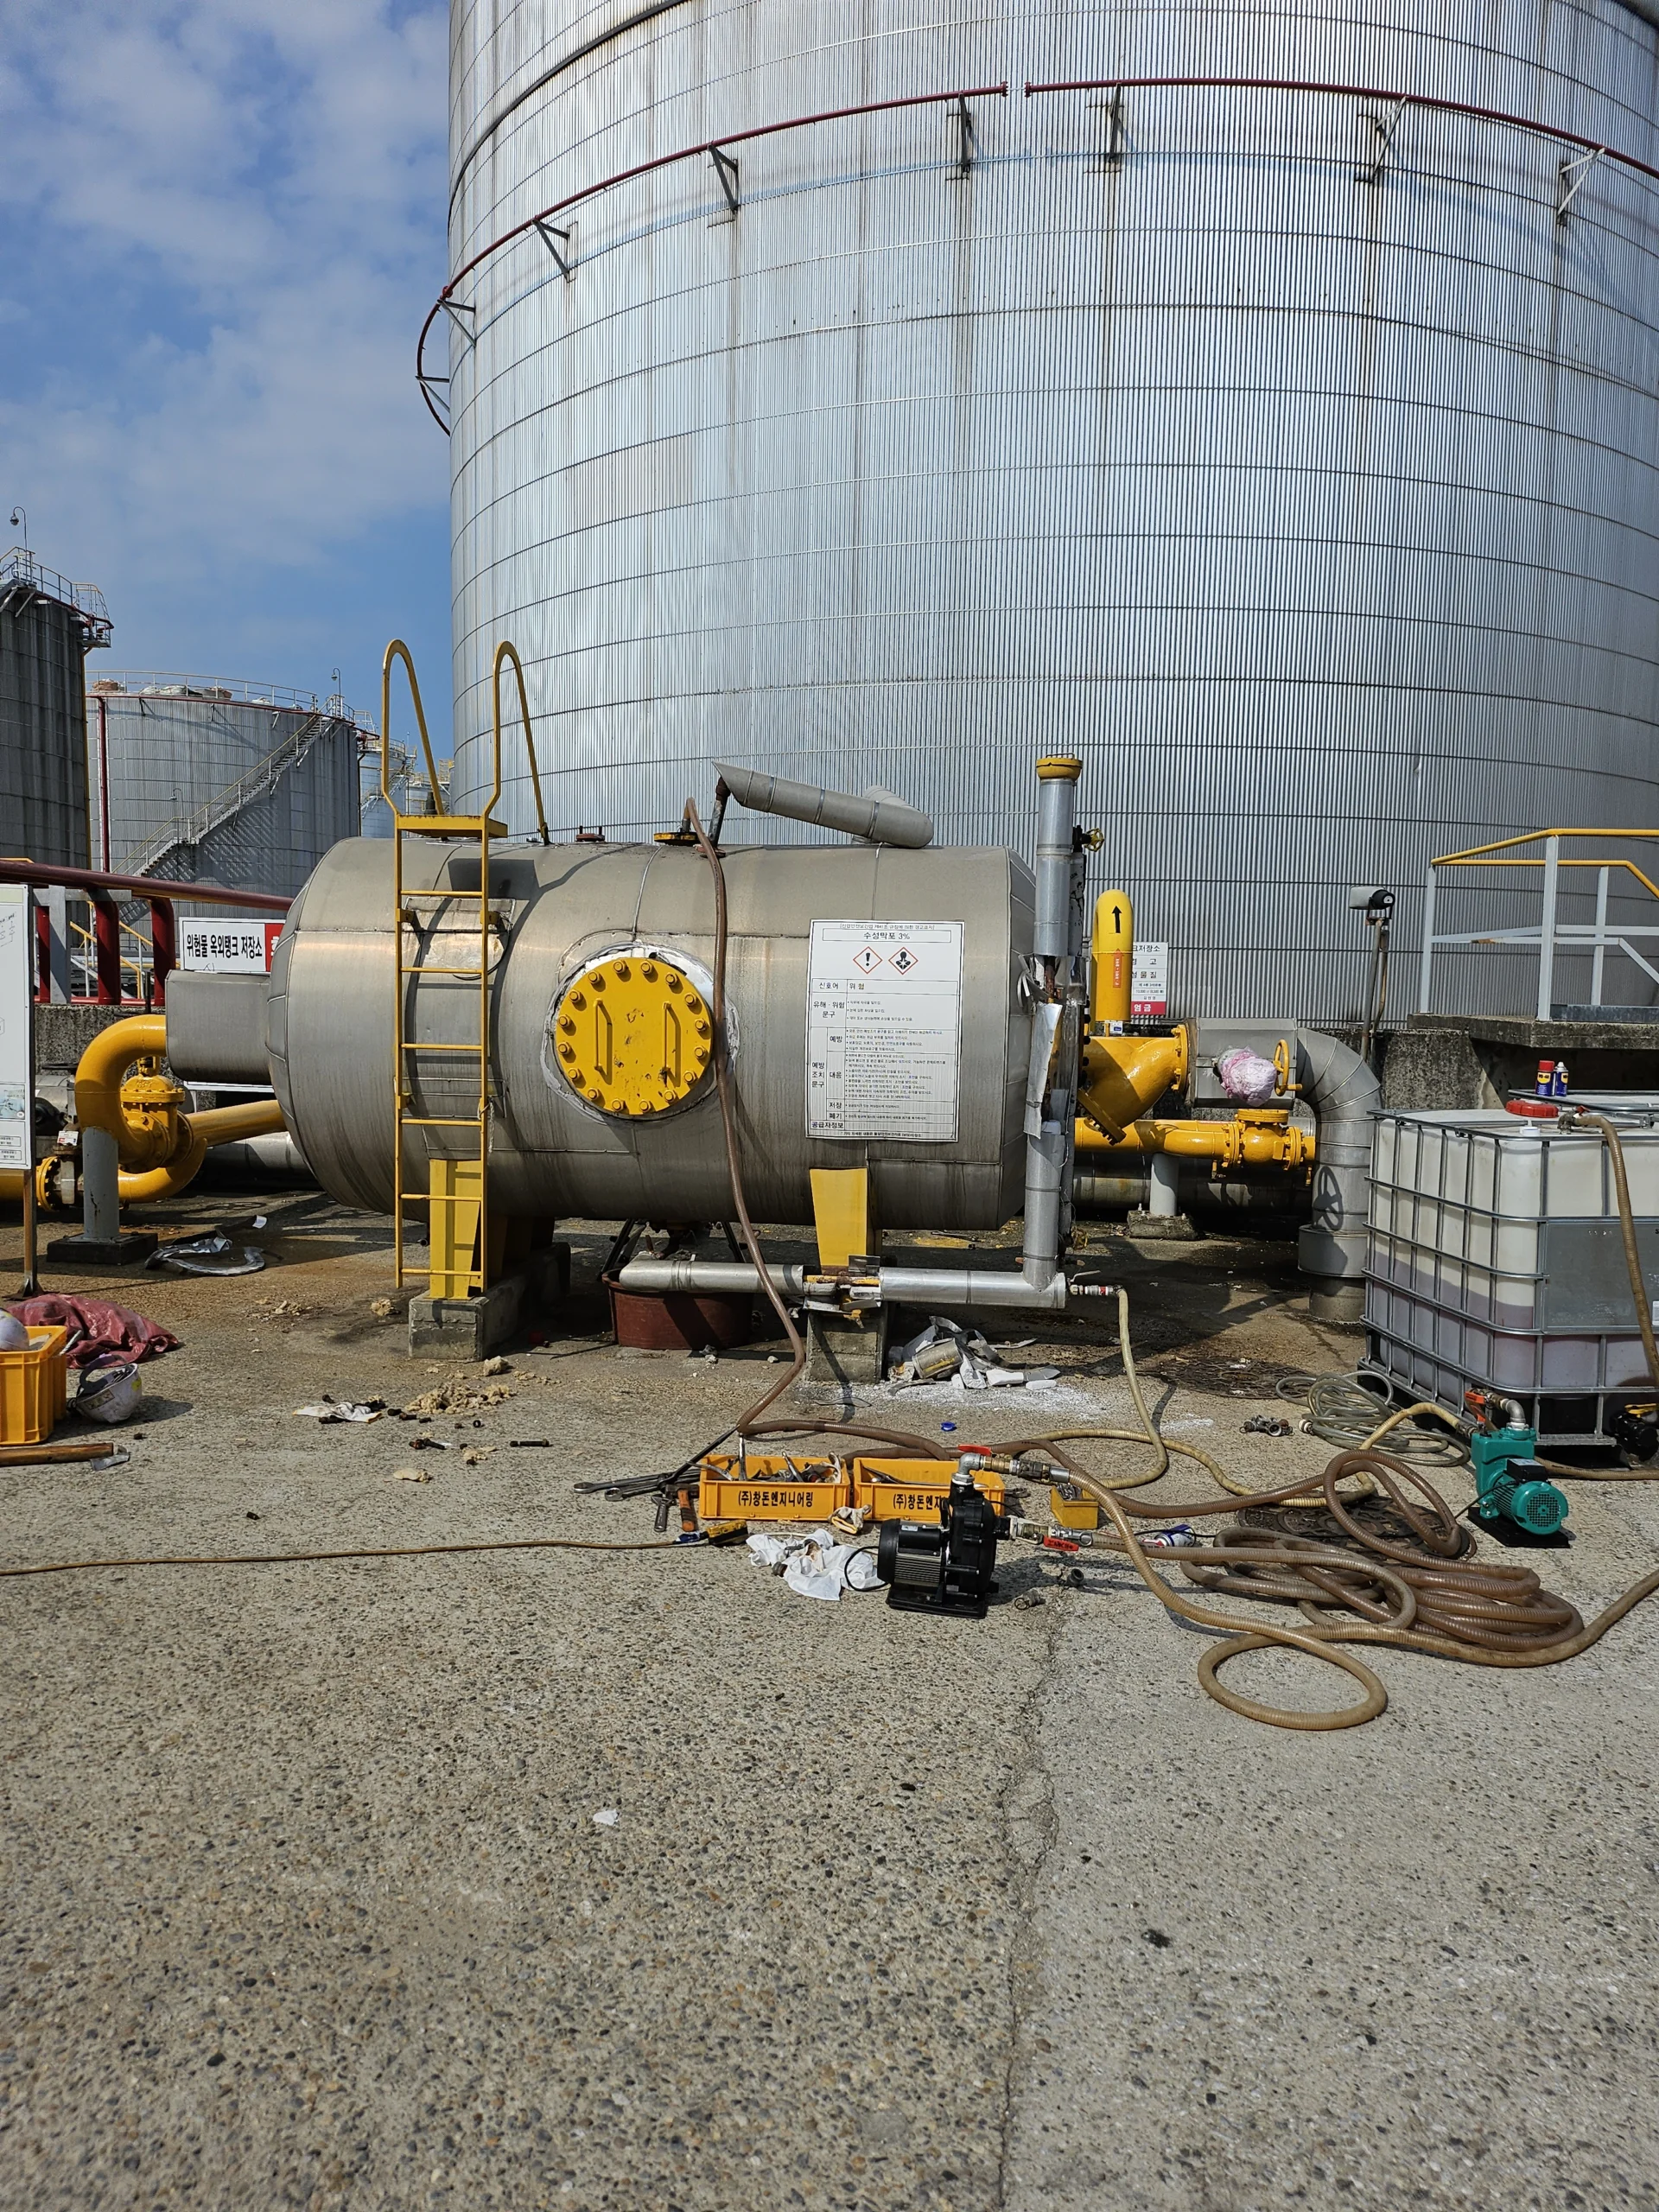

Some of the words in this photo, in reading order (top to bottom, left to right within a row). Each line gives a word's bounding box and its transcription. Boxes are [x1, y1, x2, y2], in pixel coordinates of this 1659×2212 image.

[187, 933, 207, 957] 위험물
[210, 934, 239, 958] 옥외탱크
[241, 935, 262, 959] 저장소
[819, 982, 839, 990] 신호어
[823, 1010, 836, 1019] 문구
[812, 1061, 825, 1070] 예방
[811, 1071, 825, 1079] 조치
[830, 1071, 842, 1079] 대응
[811, 1080, 825, 1089] 문구
[811, 1121, 844, 1129] 공급자정보
[738, 1490, 814, 1508] (주)창돈엔지니어링
[893, 1493, 944, 1510] (주)창돈엔지
